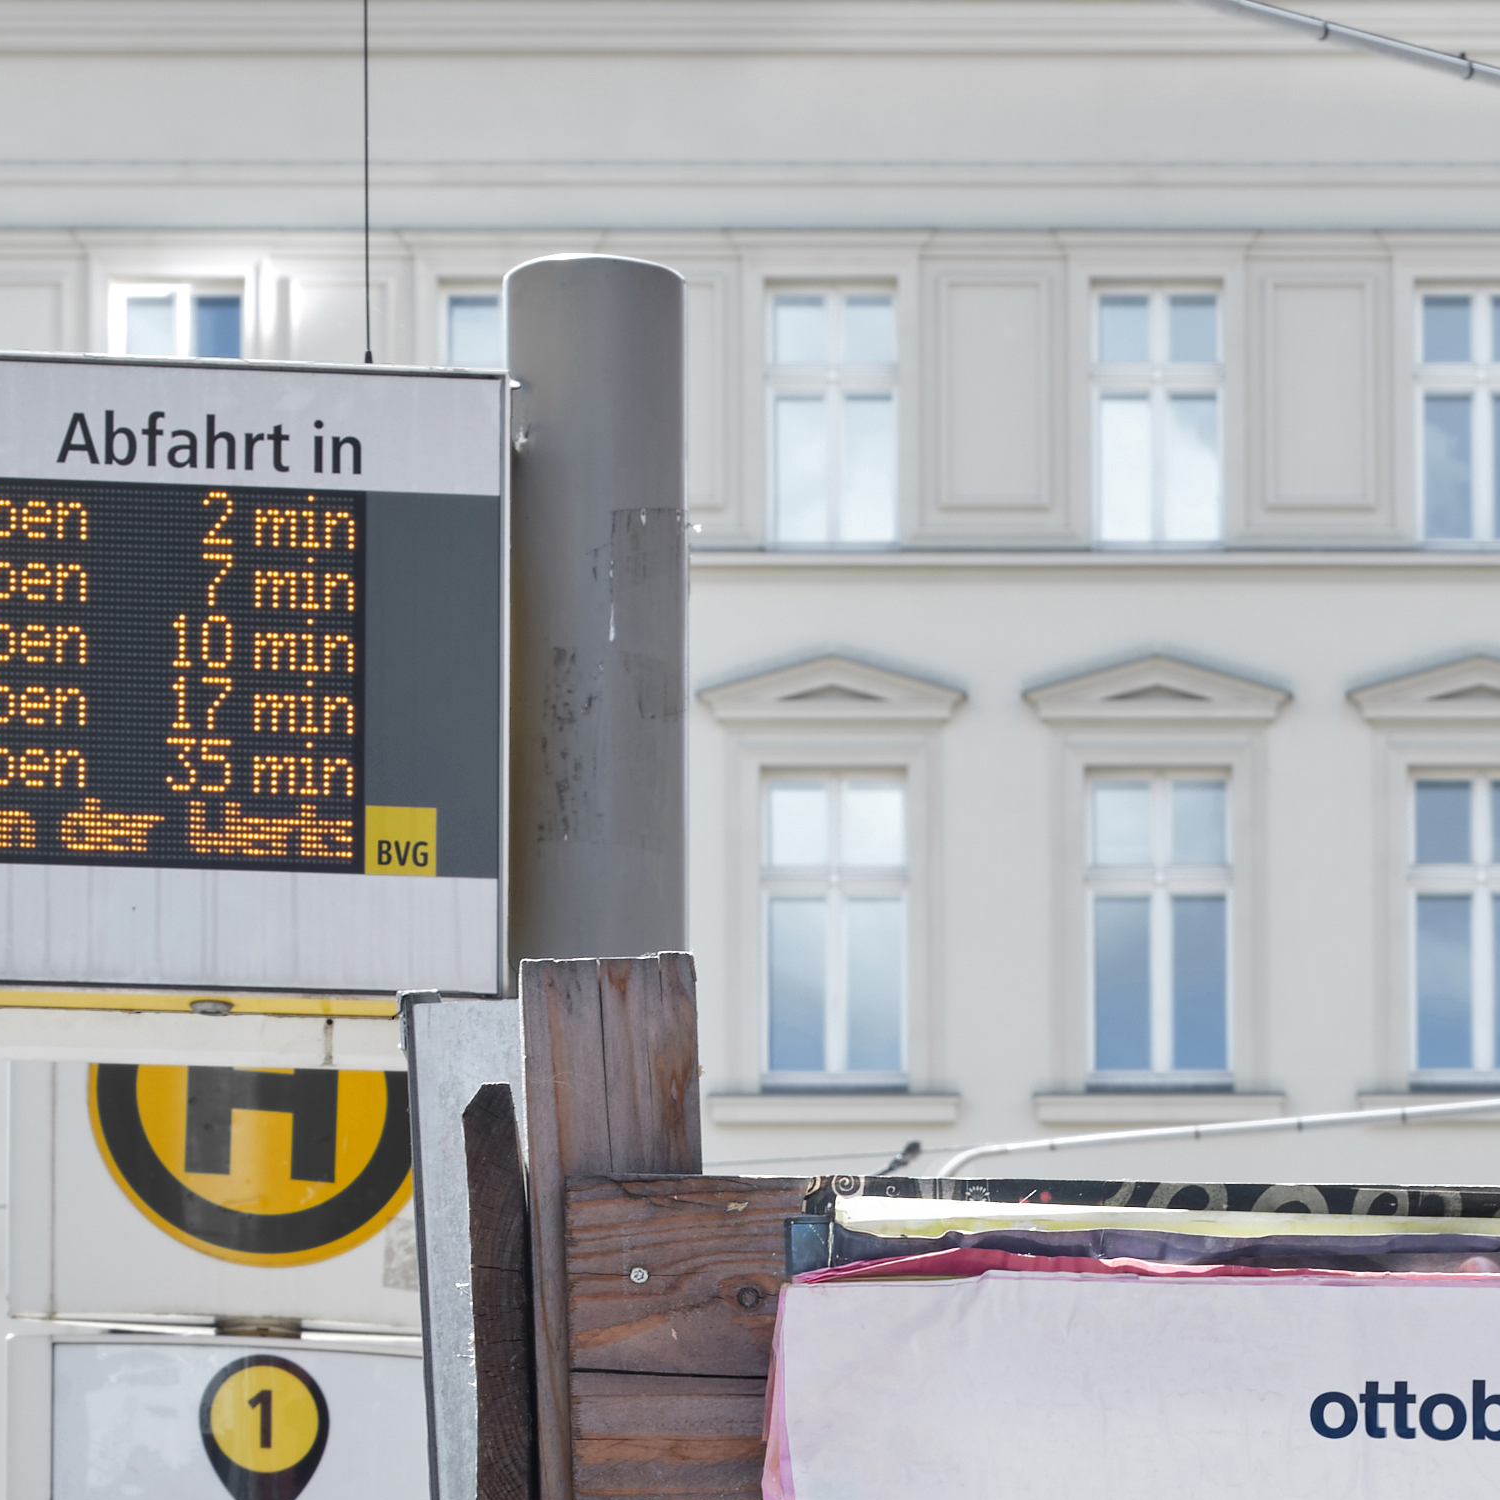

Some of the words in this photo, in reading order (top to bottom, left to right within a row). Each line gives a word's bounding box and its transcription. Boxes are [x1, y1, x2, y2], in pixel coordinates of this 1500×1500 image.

[57, 410, 289, 472] Abfahrt
[314, 420, 361, 474] in
[202, 492, 233, 545] 2
[255, 495, 355, 550] min
[202, 553, 233, 606] 7
[254, 557, 354, 611] min
[172, 614, 233, 668] 10
[254, 618, 354, 673] min
[172, 676, 232, 730] 17
[254, 680, 354, 734] min
[166, 737, 232, 792] 35
[253, 742, 353, 796] min
[61, 797, 165, 851] der
[378, 840, 428, 867] BVG
[247, 1388, 274, 1449] 1
